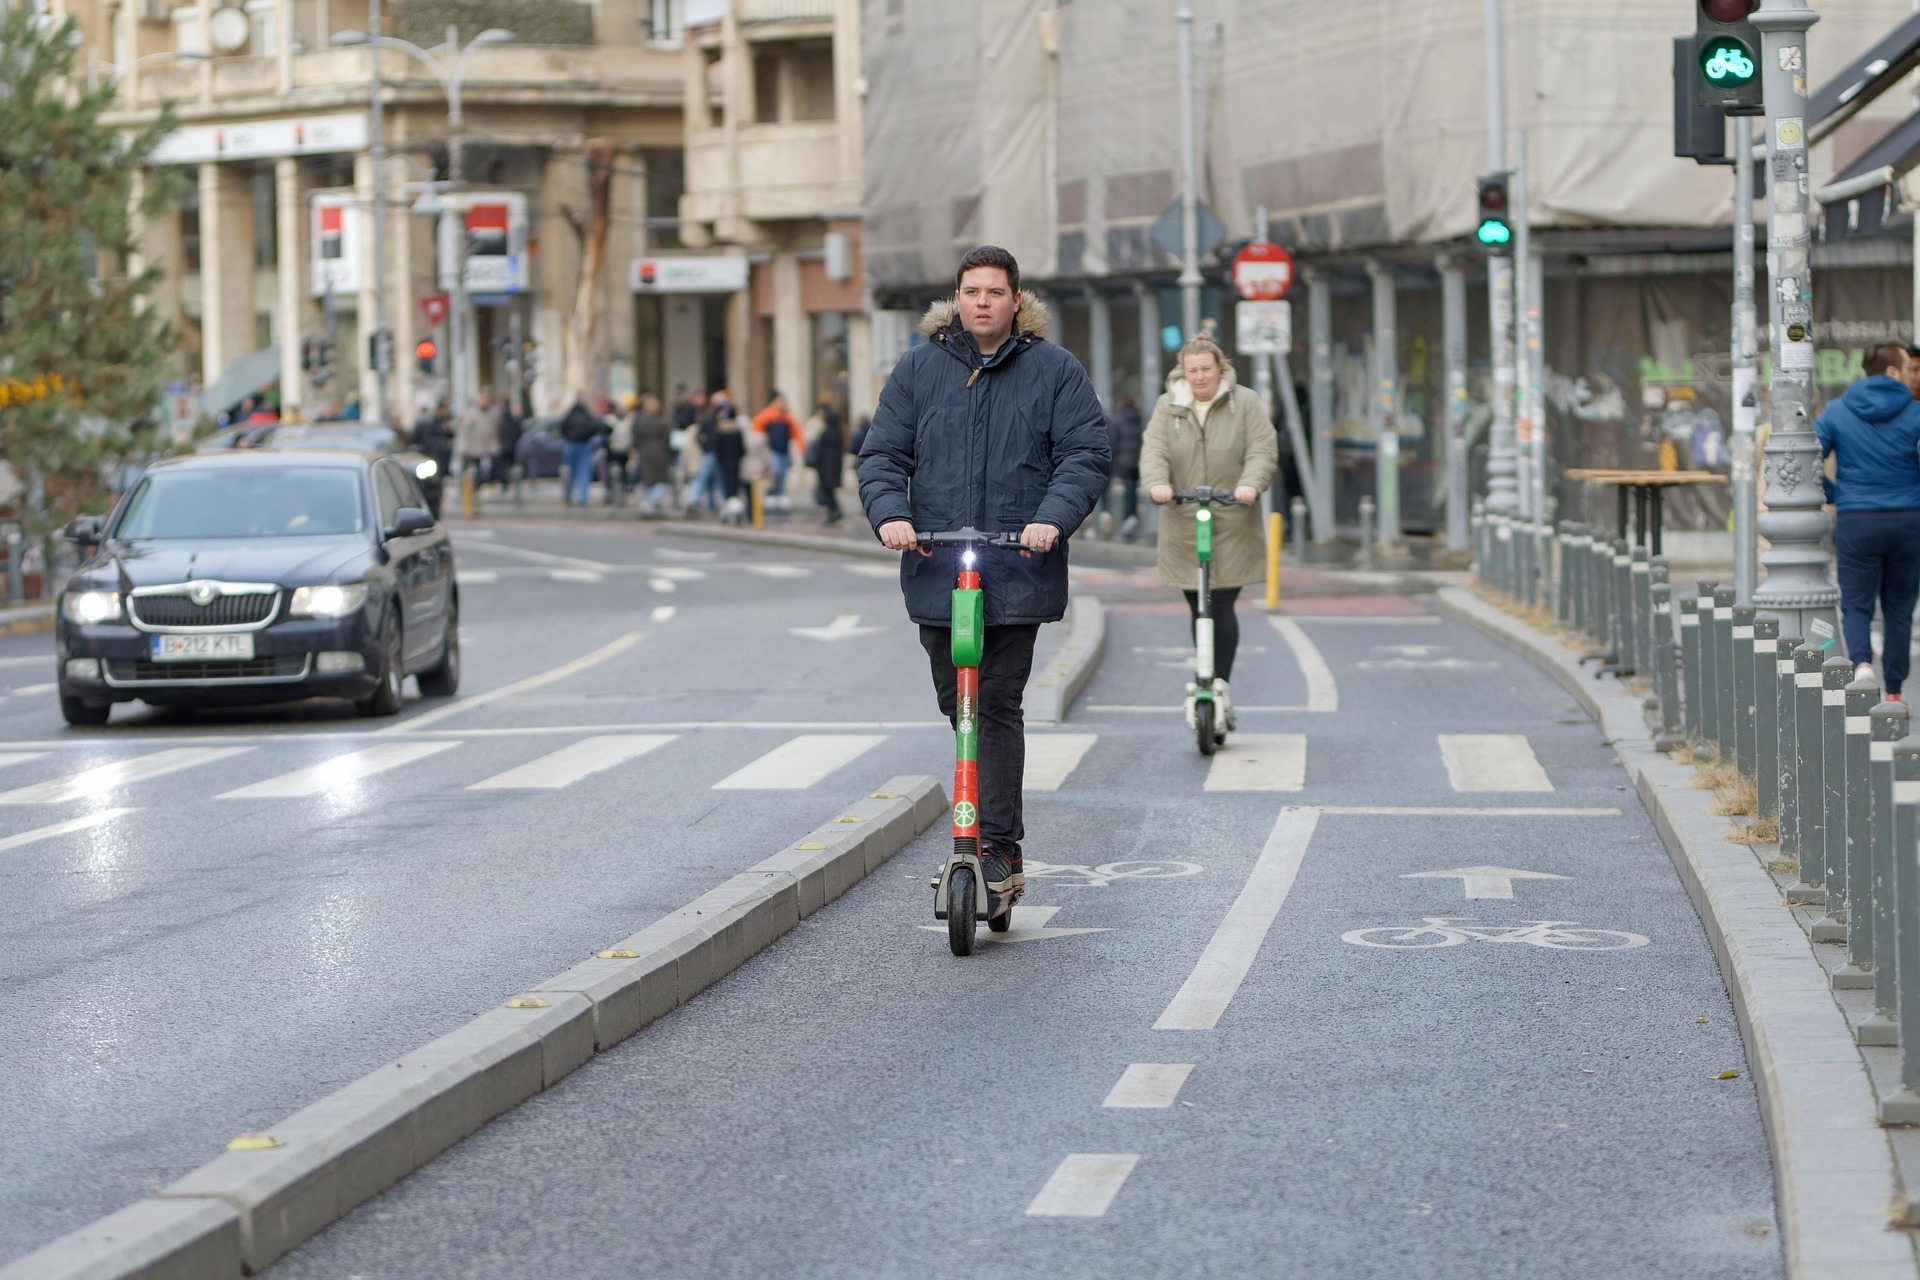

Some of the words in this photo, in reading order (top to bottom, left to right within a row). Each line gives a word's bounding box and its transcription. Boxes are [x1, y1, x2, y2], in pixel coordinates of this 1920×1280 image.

[164, 637, 176, 653] B
[183, 636, 208, 653] 212
[214, 635, 246, 652] KTL
